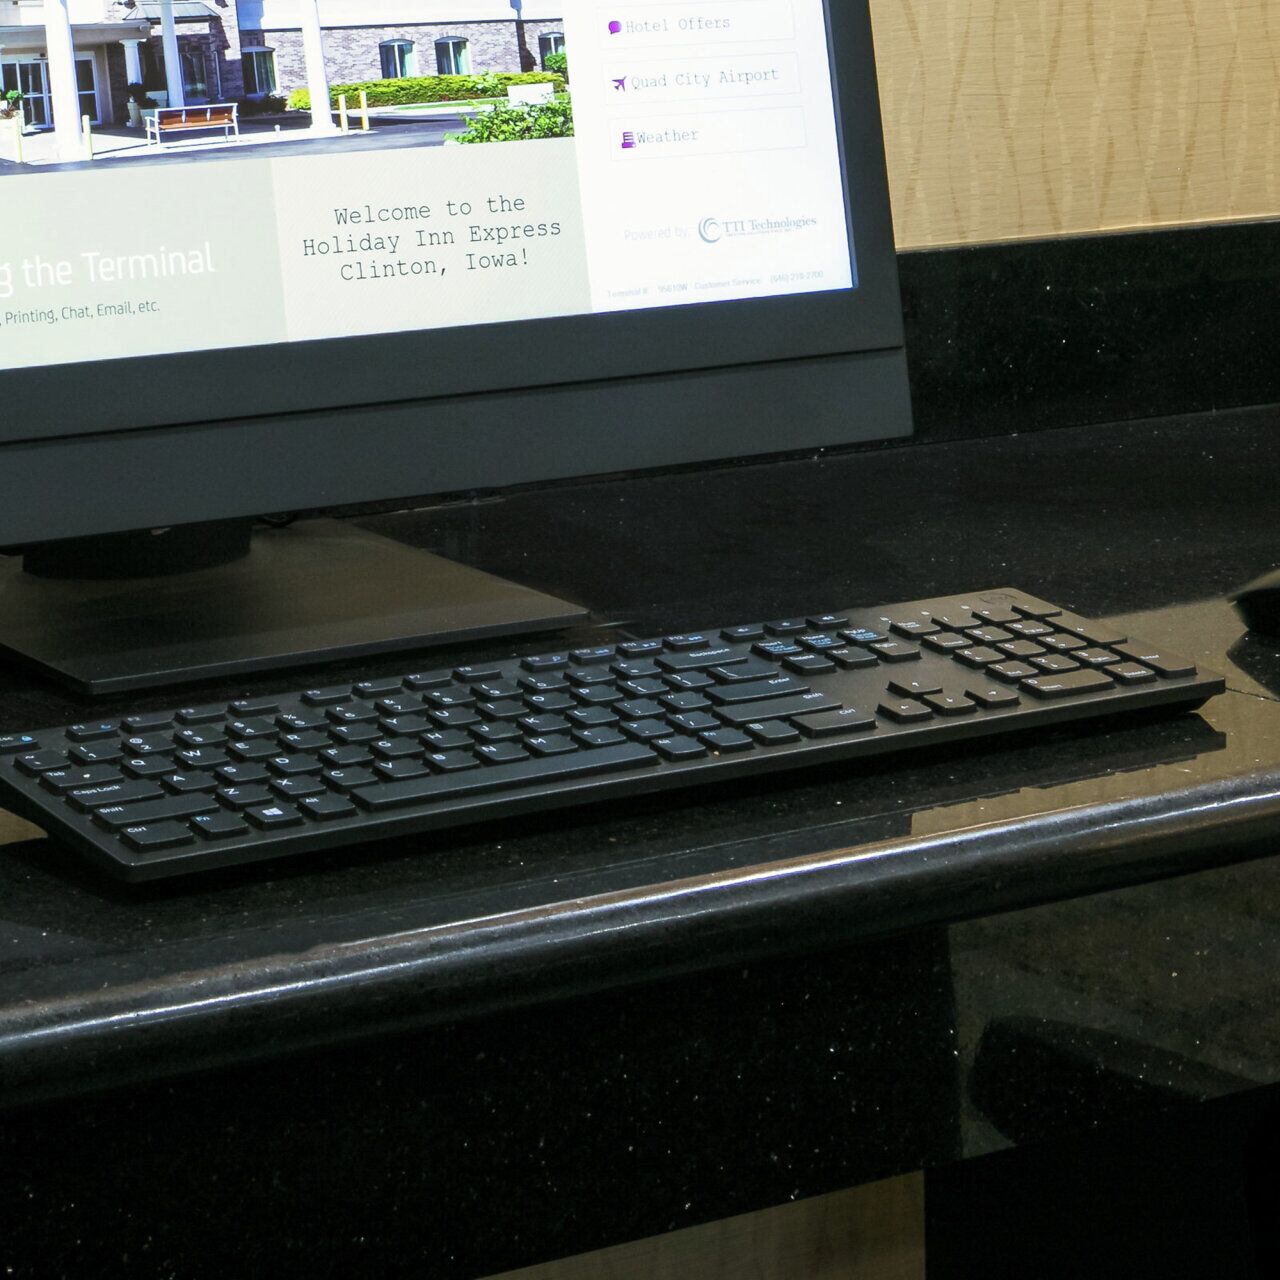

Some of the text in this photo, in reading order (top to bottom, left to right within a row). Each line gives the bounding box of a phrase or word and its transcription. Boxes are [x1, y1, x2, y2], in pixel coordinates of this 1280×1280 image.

[625, 16, 731, 34] Hotel Offers
[631, 68, 779, 91] Quad City Airport
[636, 127, 700, 145] Weather
[333, 194, 527, 227] Welcome to the
[302, 217, 563, 258] Holiday Inn Express
[624, 226, 672, 242] Powered
[722, 220, 745, 234] TTI
[748, 215, 818, 232] Technologies
[21, 256, 73, 288] the
[81, 242, 216, 284] Terminal
[339, 247, 530, 281] Clinton, Iowa!
[5, 306, 58, 328] Printing,
[61, 304, 94, 322] Chat,
[97, 299, 135, 319] Email,
[138, 297, 161, 314] etc.
[97, 784, 121, 793] Lock
[99, 806, 124, 814] Shift
